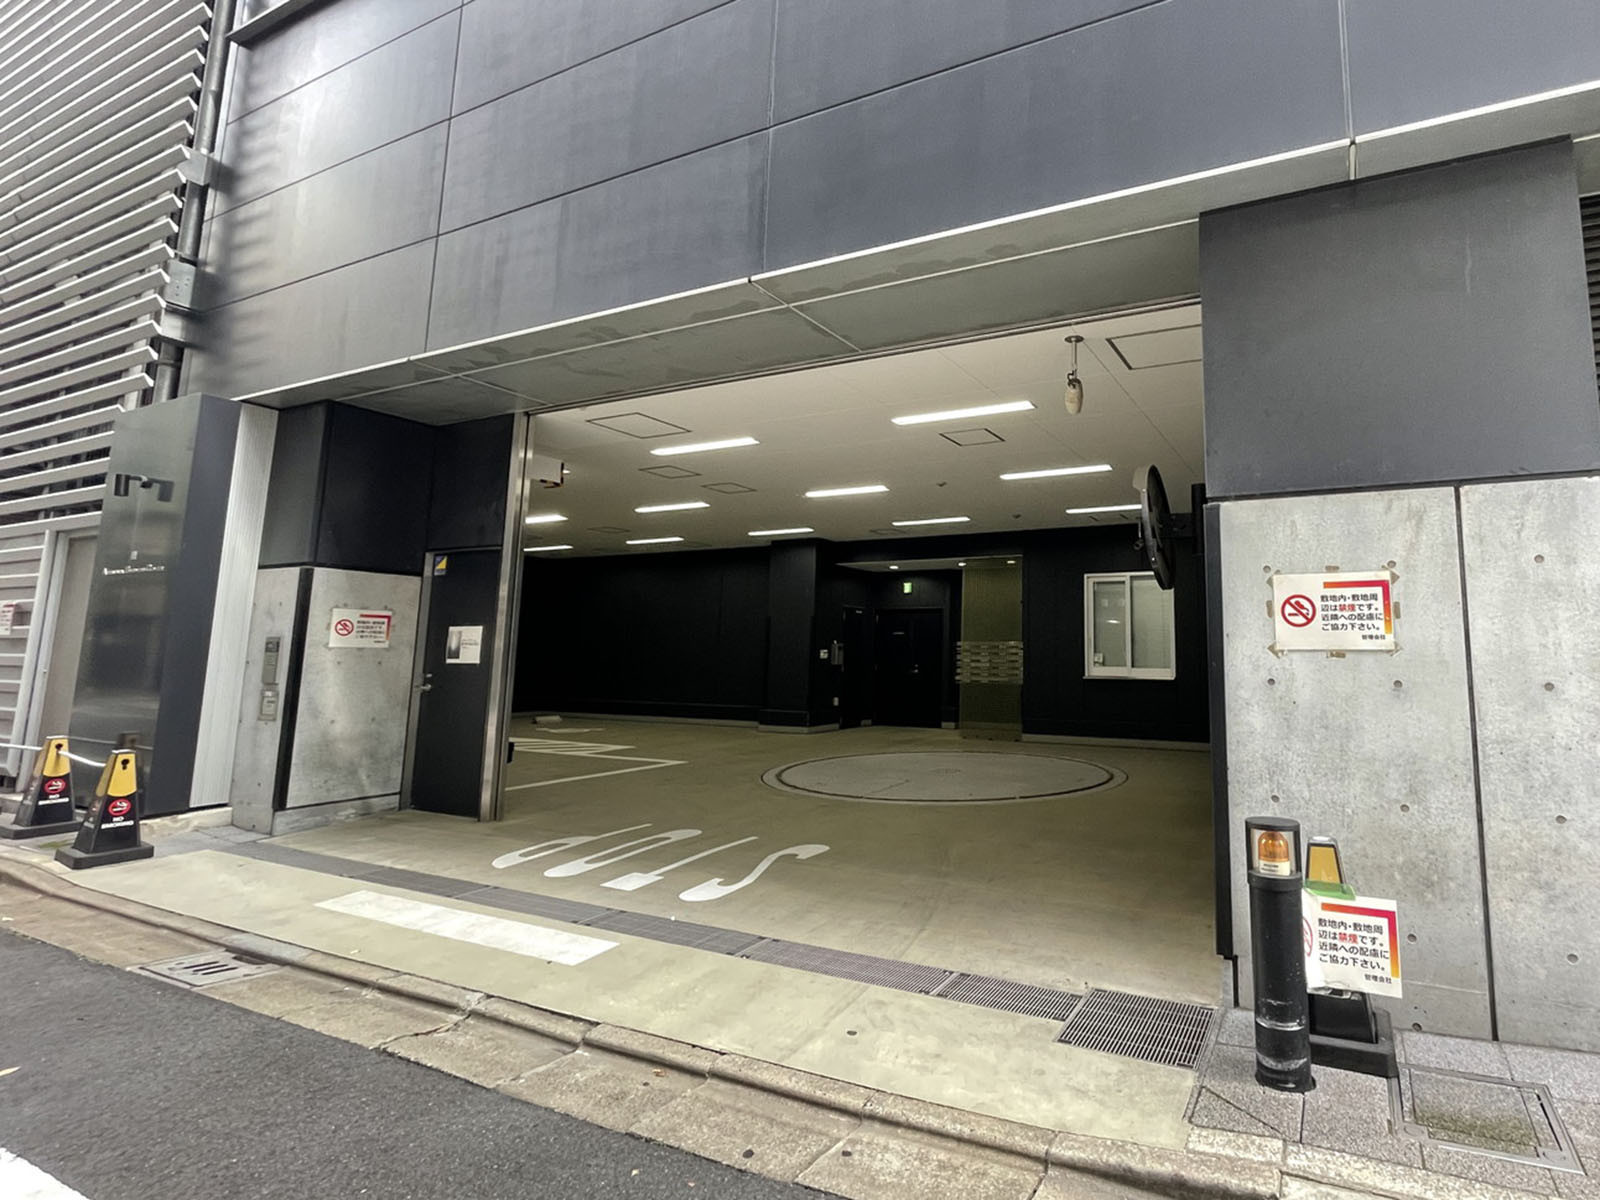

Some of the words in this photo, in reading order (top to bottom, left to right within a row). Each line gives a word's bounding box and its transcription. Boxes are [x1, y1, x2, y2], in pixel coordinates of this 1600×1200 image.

[1321, 622, 1380, 631] ご協力下さい。
[491, 823, 831, 902] STOP
[1319, 952, 1385, 971] ご協力下さい。
